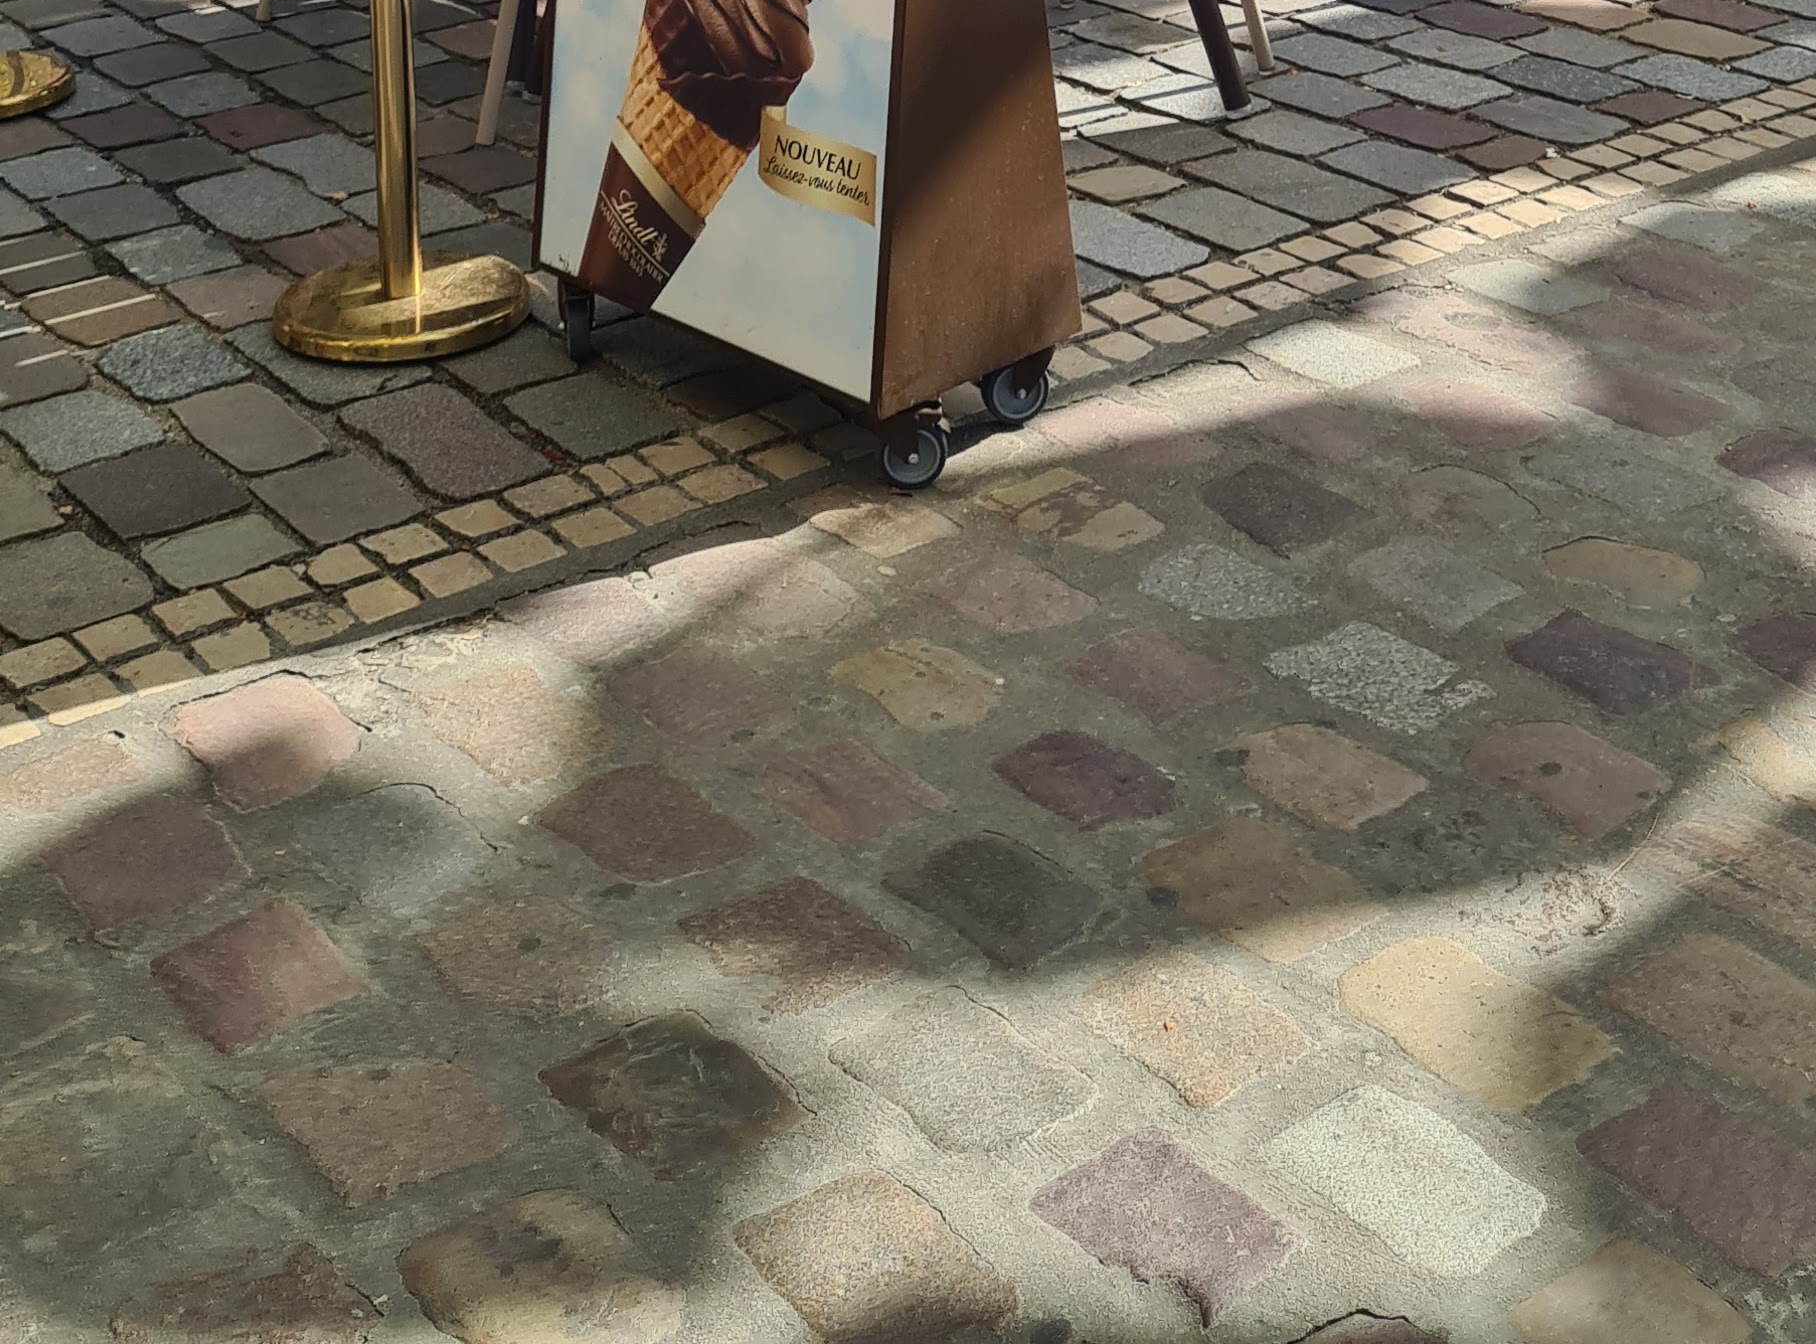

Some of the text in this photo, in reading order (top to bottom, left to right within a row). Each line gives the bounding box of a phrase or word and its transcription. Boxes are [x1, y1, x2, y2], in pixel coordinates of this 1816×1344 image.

[763, 155, 836, 193] Laissez-vous
[774, 135, 862, 181] NOUVEAU
[611, 189, 658, 245] Lindt
